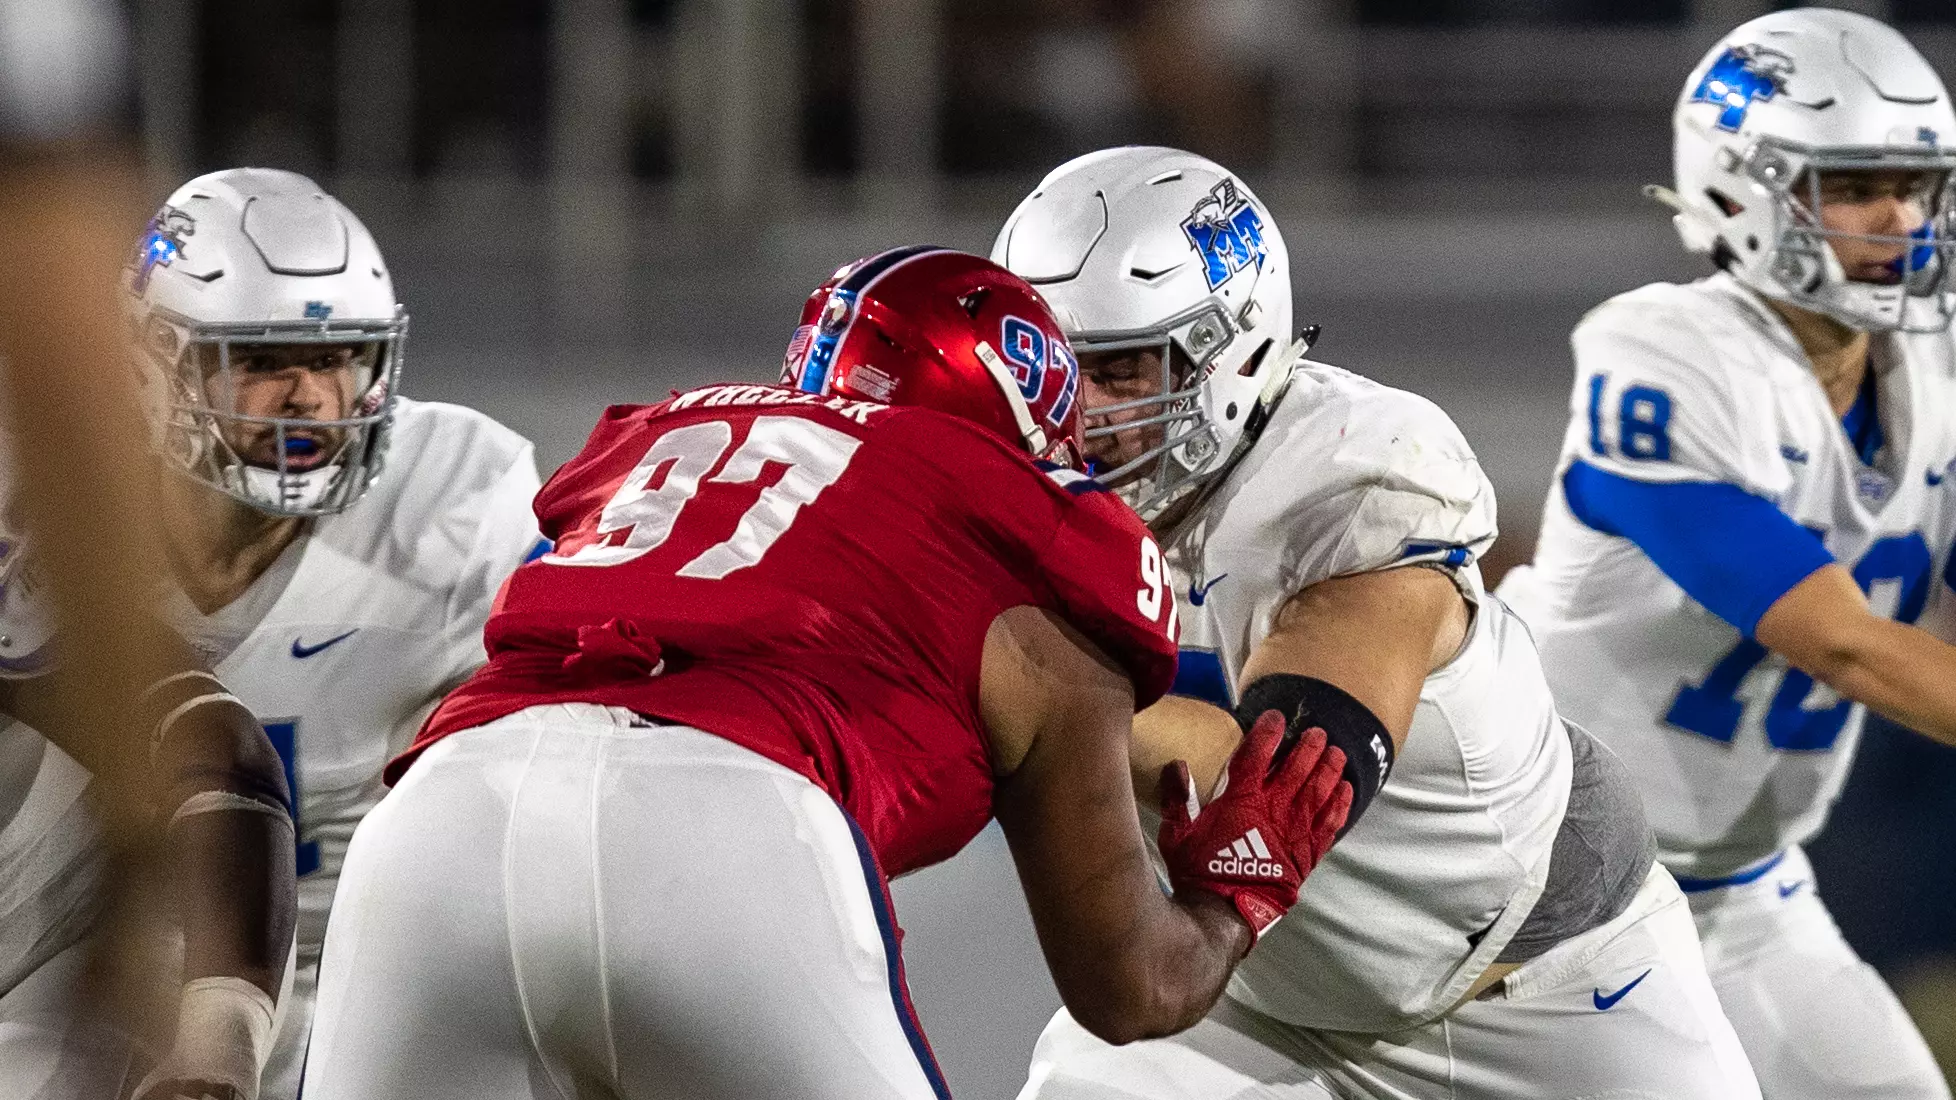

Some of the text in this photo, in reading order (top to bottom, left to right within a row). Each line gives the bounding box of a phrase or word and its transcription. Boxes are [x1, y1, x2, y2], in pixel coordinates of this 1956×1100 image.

[1001, 314, 1078, 428] 97
[1588, 372, 1673, 462] 18
[541, 415, 863, 580] 97
[1137, 536, 1178, 643] 97
[1208, 856, 1284, 878] adidas
